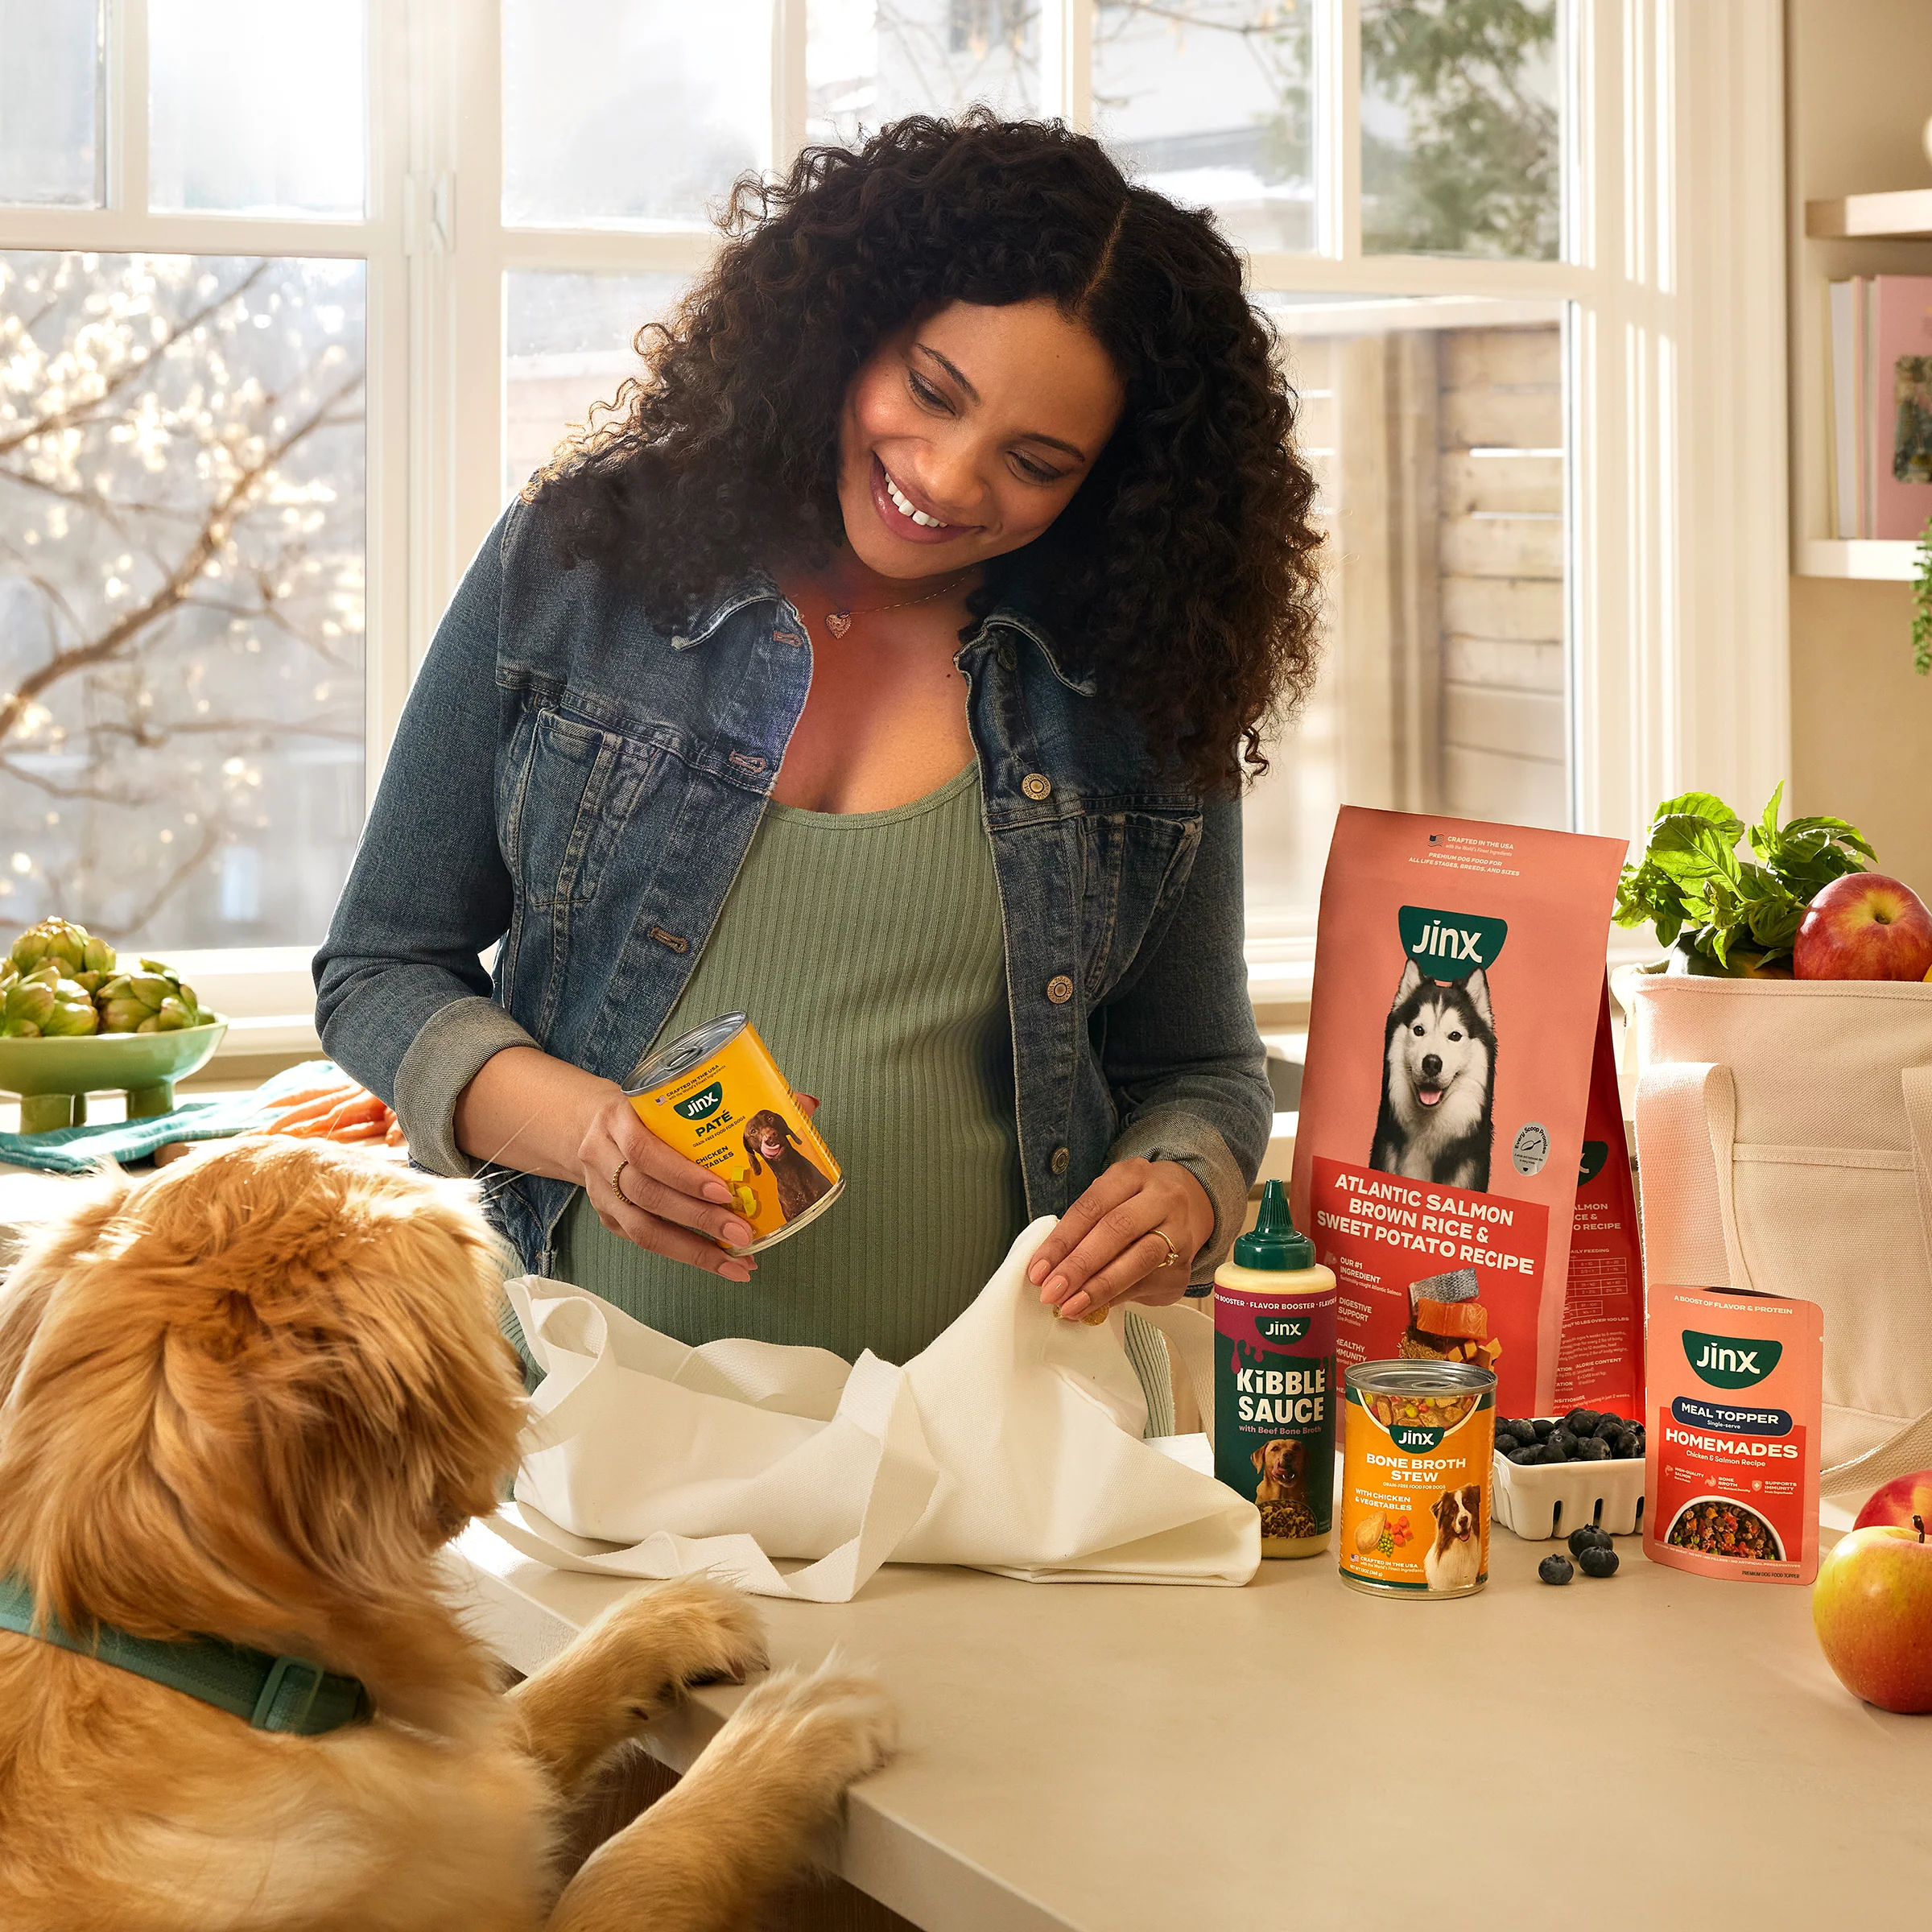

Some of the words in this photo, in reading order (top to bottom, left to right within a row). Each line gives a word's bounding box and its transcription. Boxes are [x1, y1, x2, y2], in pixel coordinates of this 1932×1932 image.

[1447, 836, 1478, 845] CRAFTED
[1428, 852, 1457, 861] PREMIUM
[1435, 860, 1459, 869] STAGES,
[1459, 864, 1486, 872] BREEDS,
[667, 1082, 691, 1096] CRAFTED
[697, 1072, 708, 1080] THE
[708, 1065, 719, 1073] USA
[692, 1135, 714, 1147] GRAIN-FREE
[714, 1129, 726, 1137] FOOD
[734, 1116, 745, 1125] DOGS
[696, 1109, 733, 1137] PATÉ
[1515, 1132, 1525, 1149] Every
[1539, 1129, 1547, 1154] Promise
[696, 1146, 729, 1164] CHICKEN
[703, 1151, 734, 1168] TABLES
[1335, 1174, 1422, 1207] ATLANTIC
[1426, 1195, 1513, 1227] SALMON
[1349, 1198, 1417, 1228] BROWN
[1422, 1215, 1473, 1240] RICE
[1476, 1227, 1488, 1243] &
[1317, 1211, 1373, 1238] SWEET
[1375, 1227, 1455, 1259] POTATO
[1460, 1247, 1535, 1275] RECIPE
[1340, 1257, 1353, 1266] OUR
[1340, 1265, 1381, 1283] INGREDIENT
[1387, 1288, 1402, 1296] Salmon
[1220, 1295, 1245, 1307] BOOSTER
[1319, 1298, 1334, 1307] FLAVOR
[1340, 1297, 1372, 1314] DIGESTIVE
[1680, 1297, 1703, 1305] BOOST
[1714, 1302, 1746, 1311] FLAVOR
[1755, 1307, 1793, 1315] PROTEIN
[1338, 1307, 1368, 1322] SUPPORT
[1238, 1396, 1324, 1423] SAUCE
[1682, 1402, 1714, 1418] MEAL
[1715, 1410, 1779, 1424] TOPPER
[1239, 1425, 1256, 1433] with
[1258, 1426, 1278, 1435] Beef
[1707, 1420, 1740, 1430] Single-serve
[1666, 1428, 1798, 1459] HOMEMADES
[1367, 1453, 1408, 1468] BONE
[1411, 1458, 1466, 1470] BROTH
[1686, 1450, 1708, 1460] Chicken
[1715, 1455, 1740, 1465] Salmon
[1741, 1459, 1766, 1468] Recipe
[1391, 1470, 1439, 1482] STEW
[1674, 1467, 1704, 1477] HIGH-QUALITY
[1674, 1472, 1691, 1480] SALMON
[1356, 1488, 1372, 1497] WITH
[1373, 1492, 1410, 1502] CHICKEN
[1360, 1498, 1412, 1510] VEGETABLES
[1360, 1556, 1385, 1565] CRAFTED
